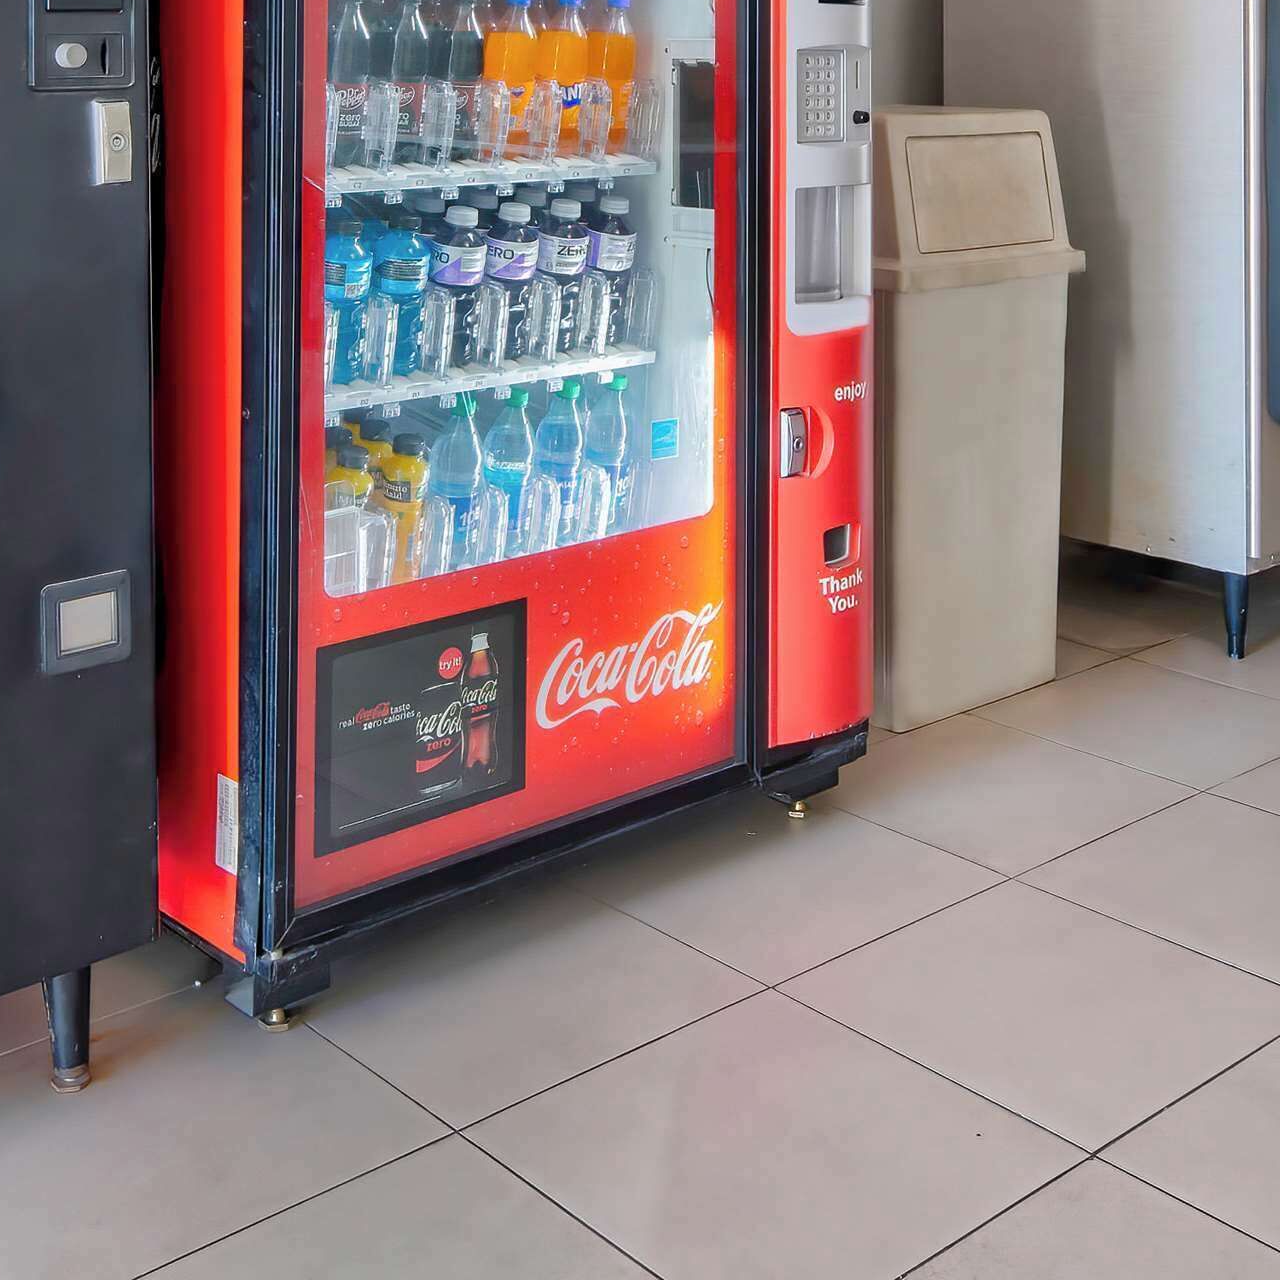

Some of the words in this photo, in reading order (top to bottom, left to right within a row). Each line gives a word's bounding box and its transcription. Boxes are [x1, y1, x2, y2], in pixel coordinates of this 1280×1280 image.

[834, 380, 866, 402] enjoy
[818, 568, 863, 595] Thank
[828, 594, 858, 614] You.
[439, 660, 451, 671] try
[451, 656, 462, 666] it!
[535, 600, 724, 729] Coca-Cola
[339, 717, 355, 729] real
[390, 703, 411, 715] taste
[363, 720, 382, 731] zero
[383, 710, 416, 725] calories
[426, 738, 451, 752] zero
